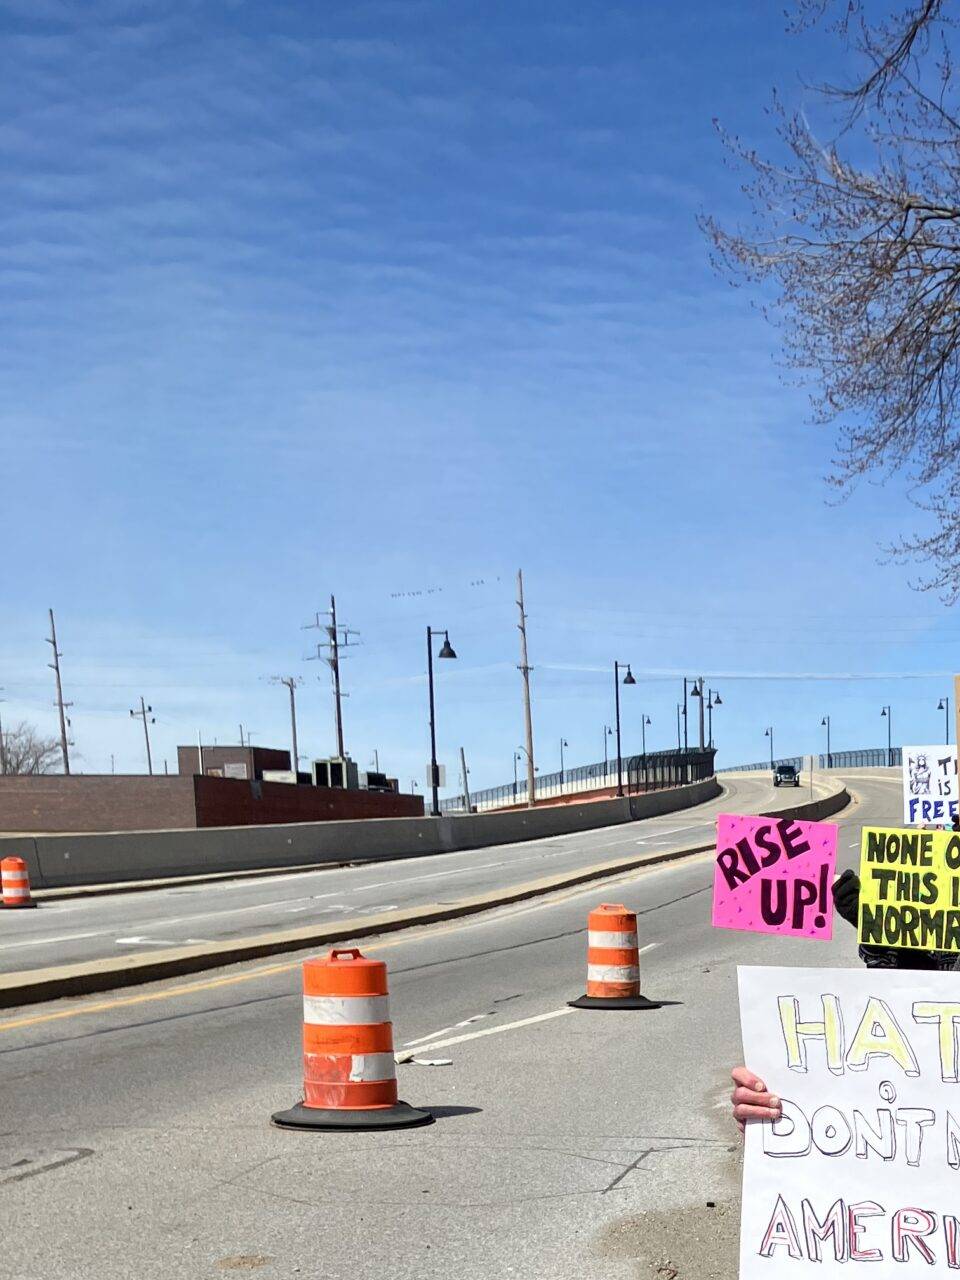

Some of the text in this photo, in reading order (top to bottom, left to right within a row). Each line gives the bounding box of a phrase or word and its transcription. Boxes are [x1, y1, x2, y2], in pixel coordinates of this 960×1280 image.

[717, 819, 811, 891] RISE
[867, 832, 933, 866] NONE
[761, 863, 829, 929] UP!
[871, 868, 938, 904] THIS
[763, 1081, 935, 1167] DON'T
